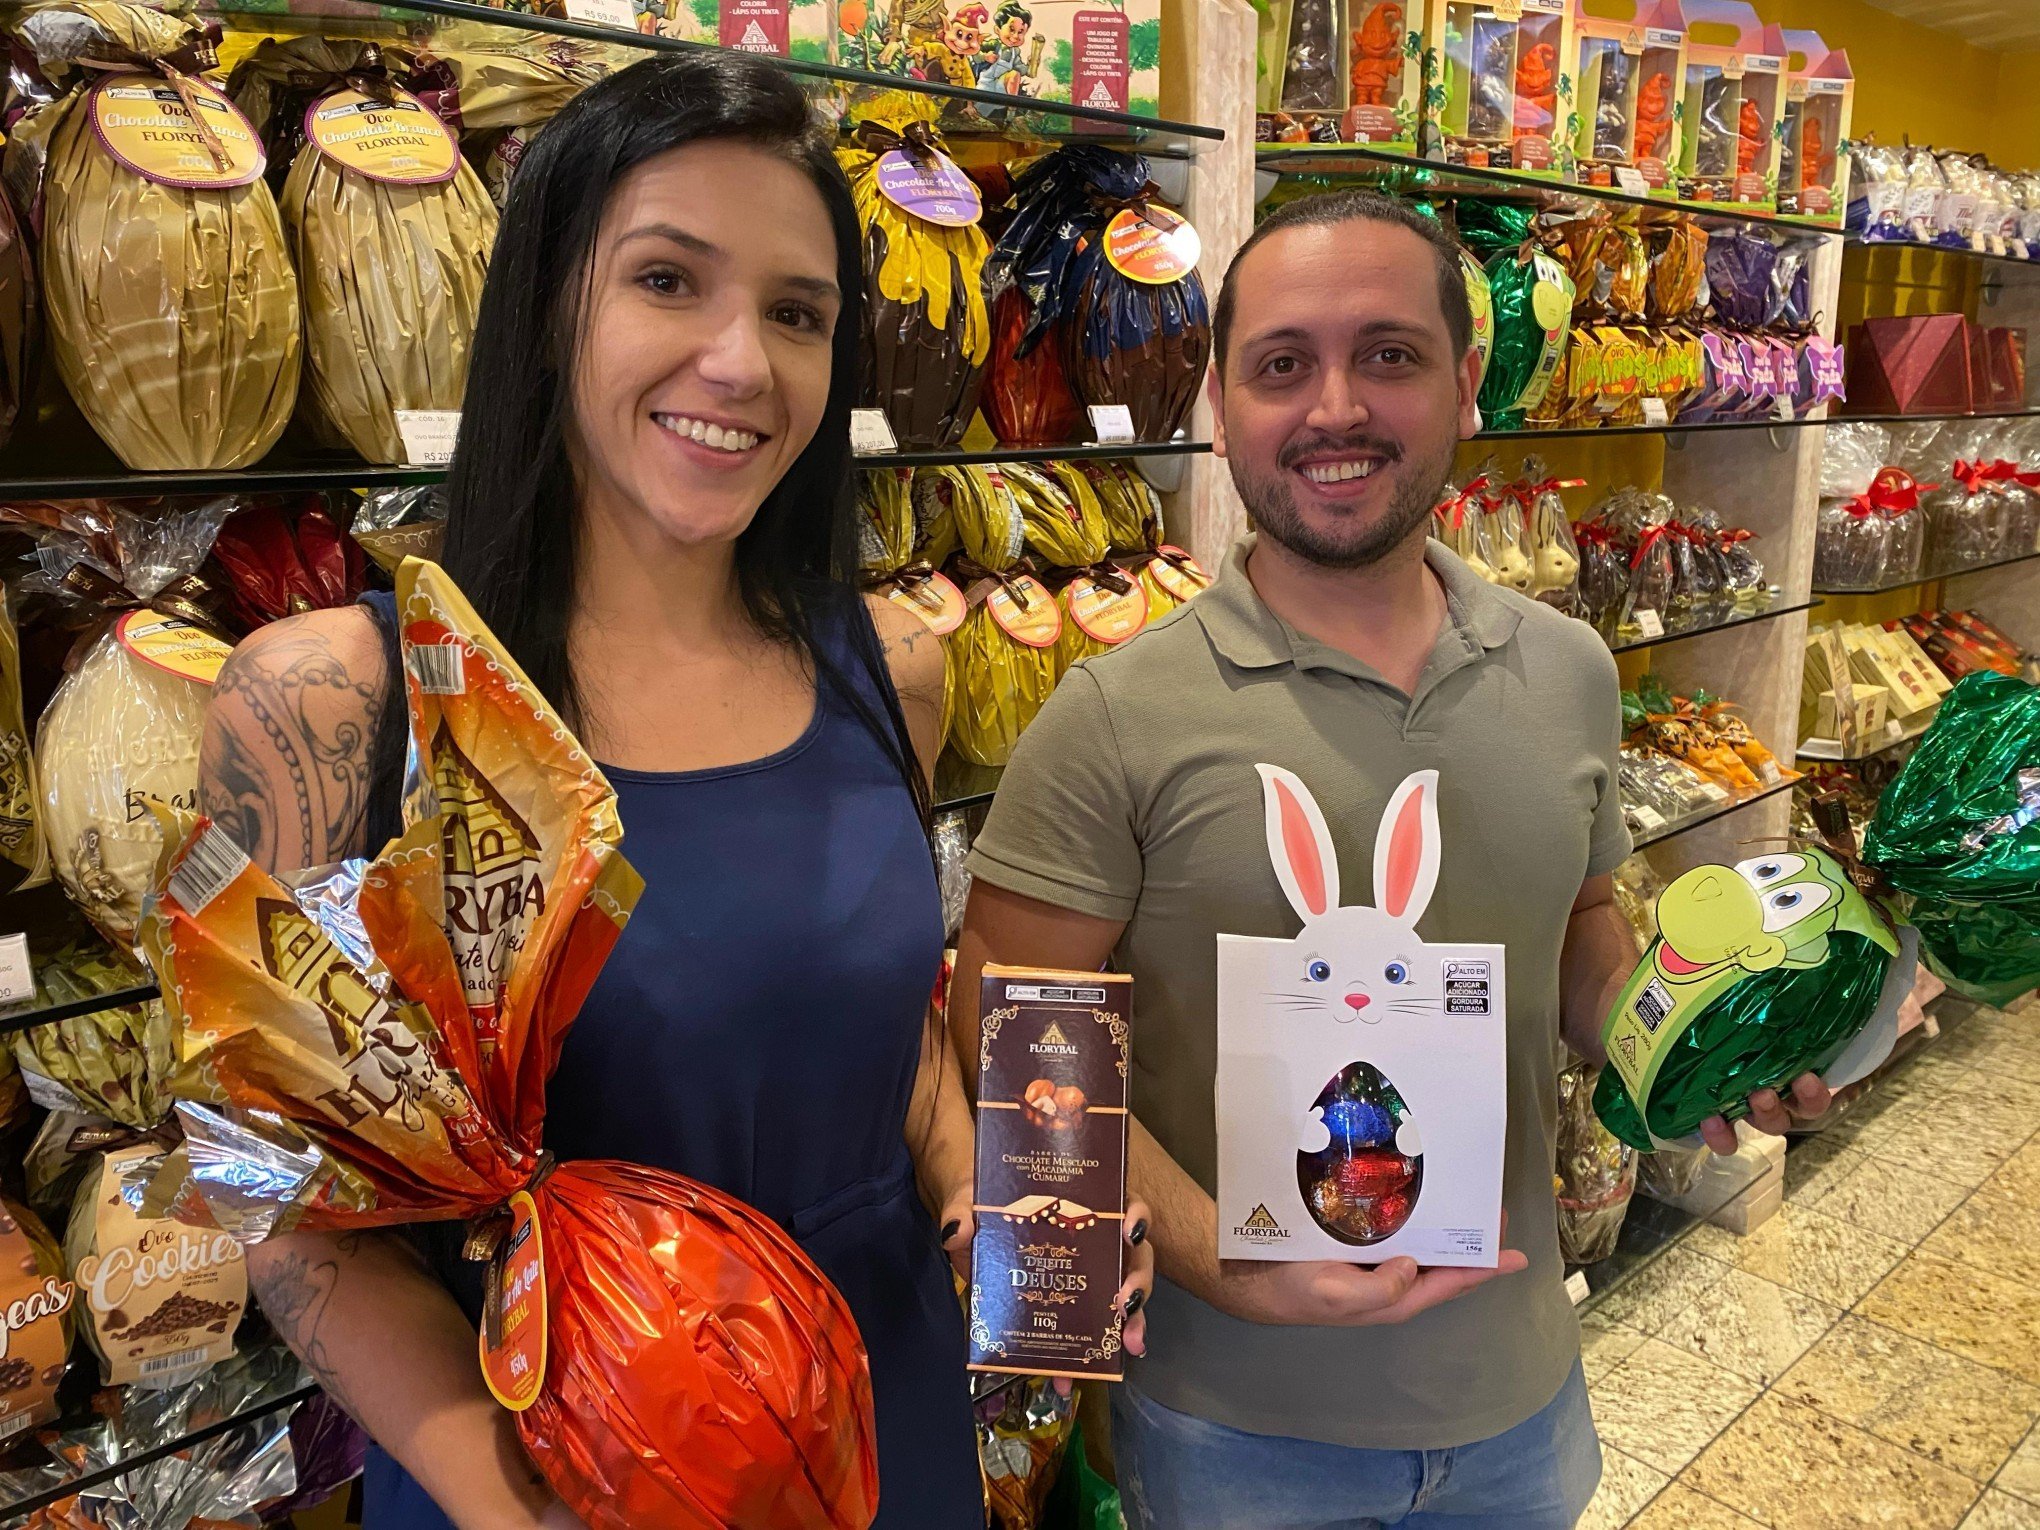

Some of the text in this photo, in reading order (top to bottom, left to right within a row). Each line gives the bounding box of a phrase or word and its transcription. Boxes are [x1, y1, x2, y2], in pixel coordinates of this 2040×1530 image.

[597, 12, 621, 24] 69,00
[1082, 100, 1120, 109] FLORYBAL
[104, 113, 188, 129] Chocolate
[364, 113, 393, 125] Ovo
[322, 123, 392, 145] Chocolate
[356, 136, 429, 151] FLORYBAL
[884, 178, 935, 189] Chocolate
[933, 205, 957, 215] 700g
[1029, 1044, 1078, 1054] FLORYBAL
[1614, 1035, 1639, 1076] FLORYBAL
[1002, 1154, 1099, 1168] CHOCOLATE MESCLADO
[1032, 1172, 1070, 1182] CUMARU
[1233, 1227, 1291, 1238] FLORYBAL
[136, 1229, 177, 1253] Ovo
[1024, 1256, 1072, 1270] DELEITE
[76, 1233, 245, 1312] Cookies
[1008, 1269, 1087, 1292] DEUSES
[1033, 1317, 1057, 1330] 110g
